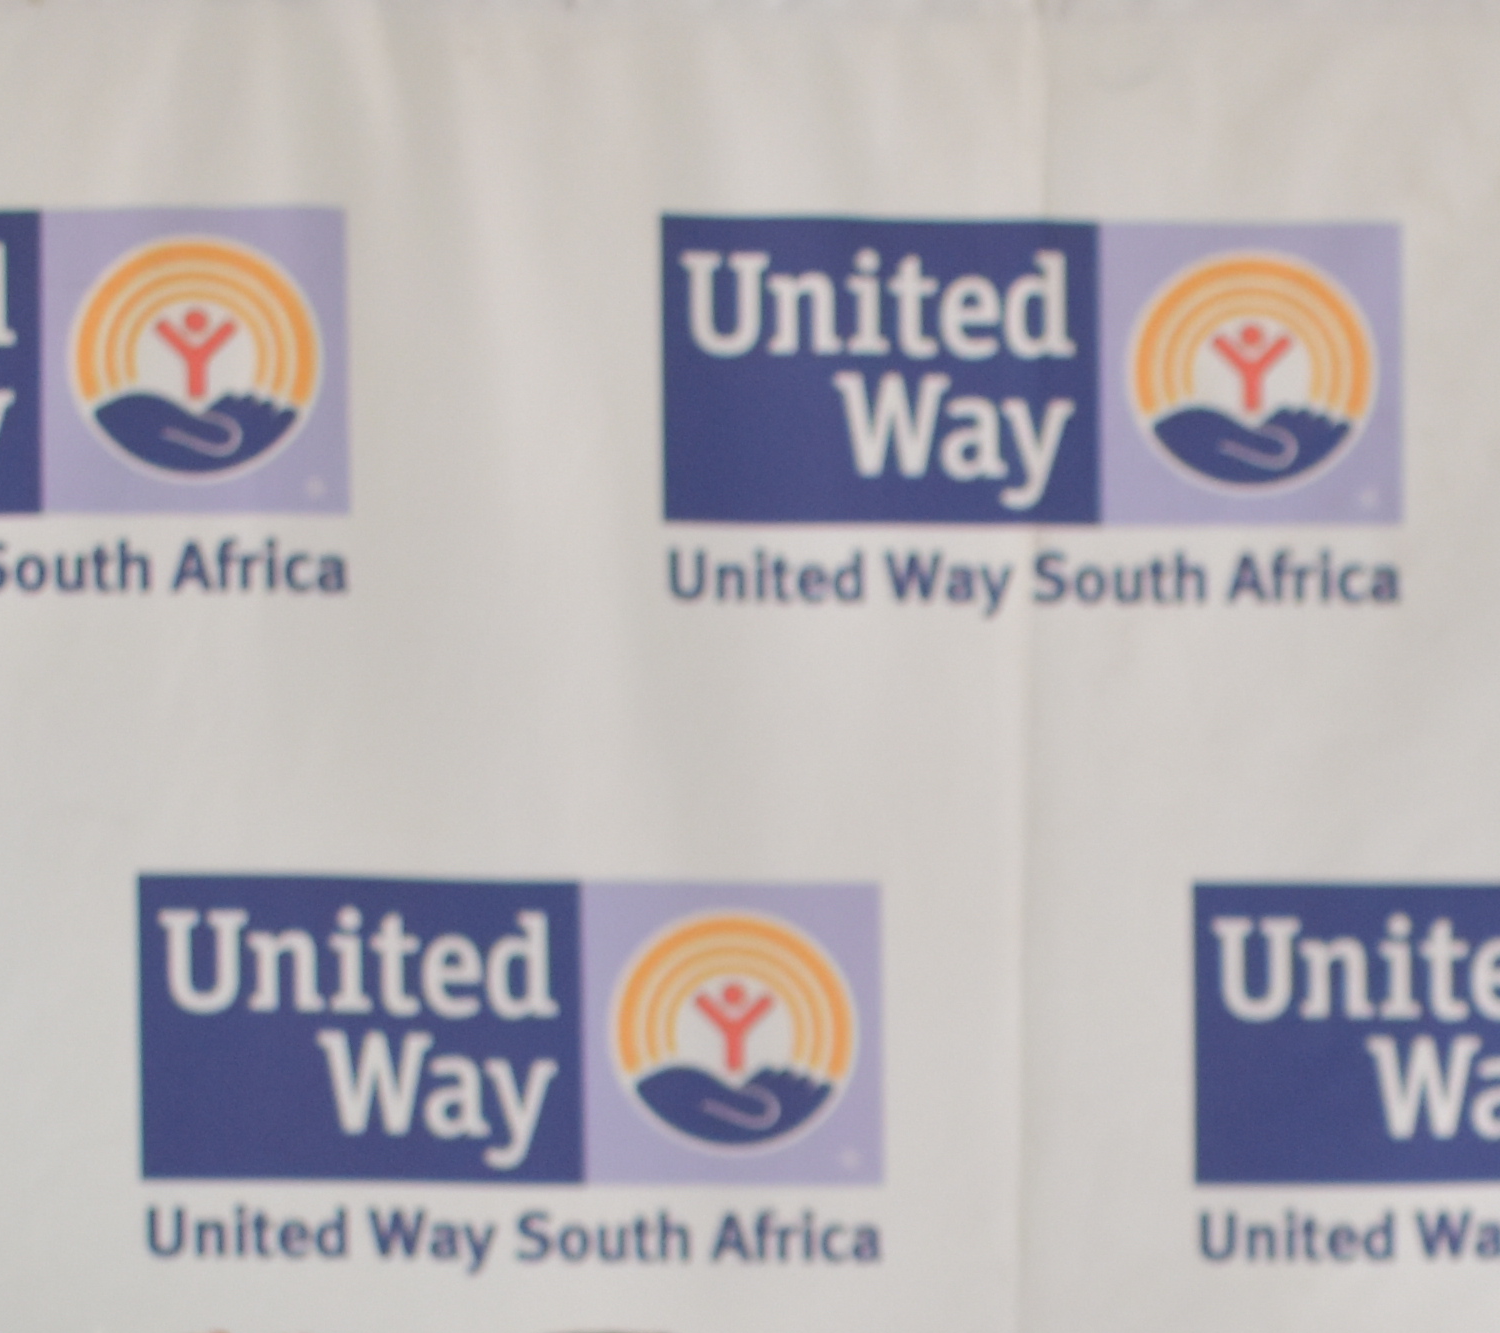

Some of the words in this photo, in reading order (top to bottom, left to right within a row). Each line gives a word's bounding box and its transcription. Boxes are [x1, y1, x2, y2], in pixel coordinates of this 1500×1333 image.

[681, 249, 1075, 360] United
[834, 372, 1073, 510] Way
[172, 537, 348, 594] Africa
[666, 549, 865, 606] United
[883, 550, 1012, 615] Way
[1034, 550, 1207, 606] South
[1227, 547, 1402, 604] Africa
[159, 906, 559, 1019] United
[317, 1030, 557, 1169] Way
[145, 1206, 349, 1262] United
[370, 1207, 495, 1275] Way
[515, 1210, 691, 1265] South
[710, 1210, 882, 1265] Africa
[1196, 1209, 1395, 1264] United
